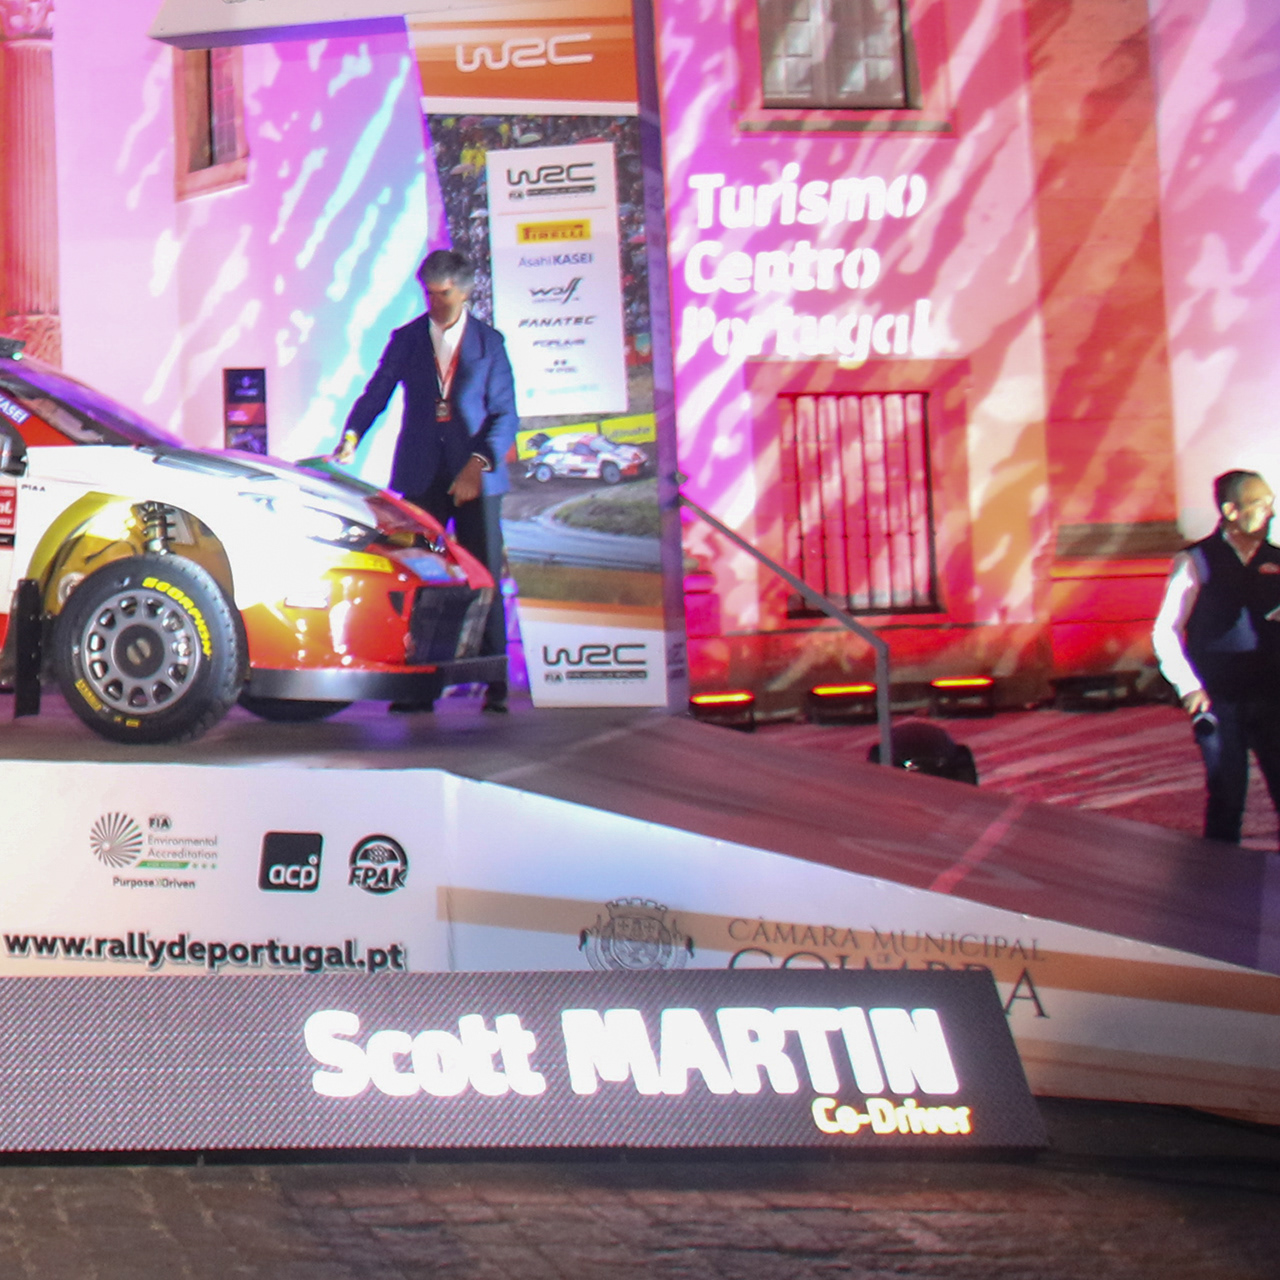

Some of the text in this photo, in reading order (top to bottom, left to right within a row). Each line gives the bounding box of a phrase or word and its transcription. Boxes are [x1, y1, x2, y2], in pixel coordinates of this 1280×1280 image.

[455, 32, 594, 73] WRC
[507, 163, 595, 186] WRC
[688, 162, 927, 229] Turismo
[684, 240, 880, 294] Centro
[518, 315, 597, 328] FANATEC
[676, 298, 936, 369] Portugal
[543, 643, 647, 666] WRC
[149, 817, 171, 829] FIA
[148, 835, 218, 846] Environmental
[148, 848, 218, 859] Accreditation
[269, 864, 318, 889] acp
[349, 866, 408, 889] FPAK
[3, 931, 406, 972] www.rallydeportugal.pt
[871, 926, 1048, 962] MUNICIPAL
[304, 1006, 960, 1097] Scott MARTIN
[811, 1097, 973, 1134] Co-Driver
